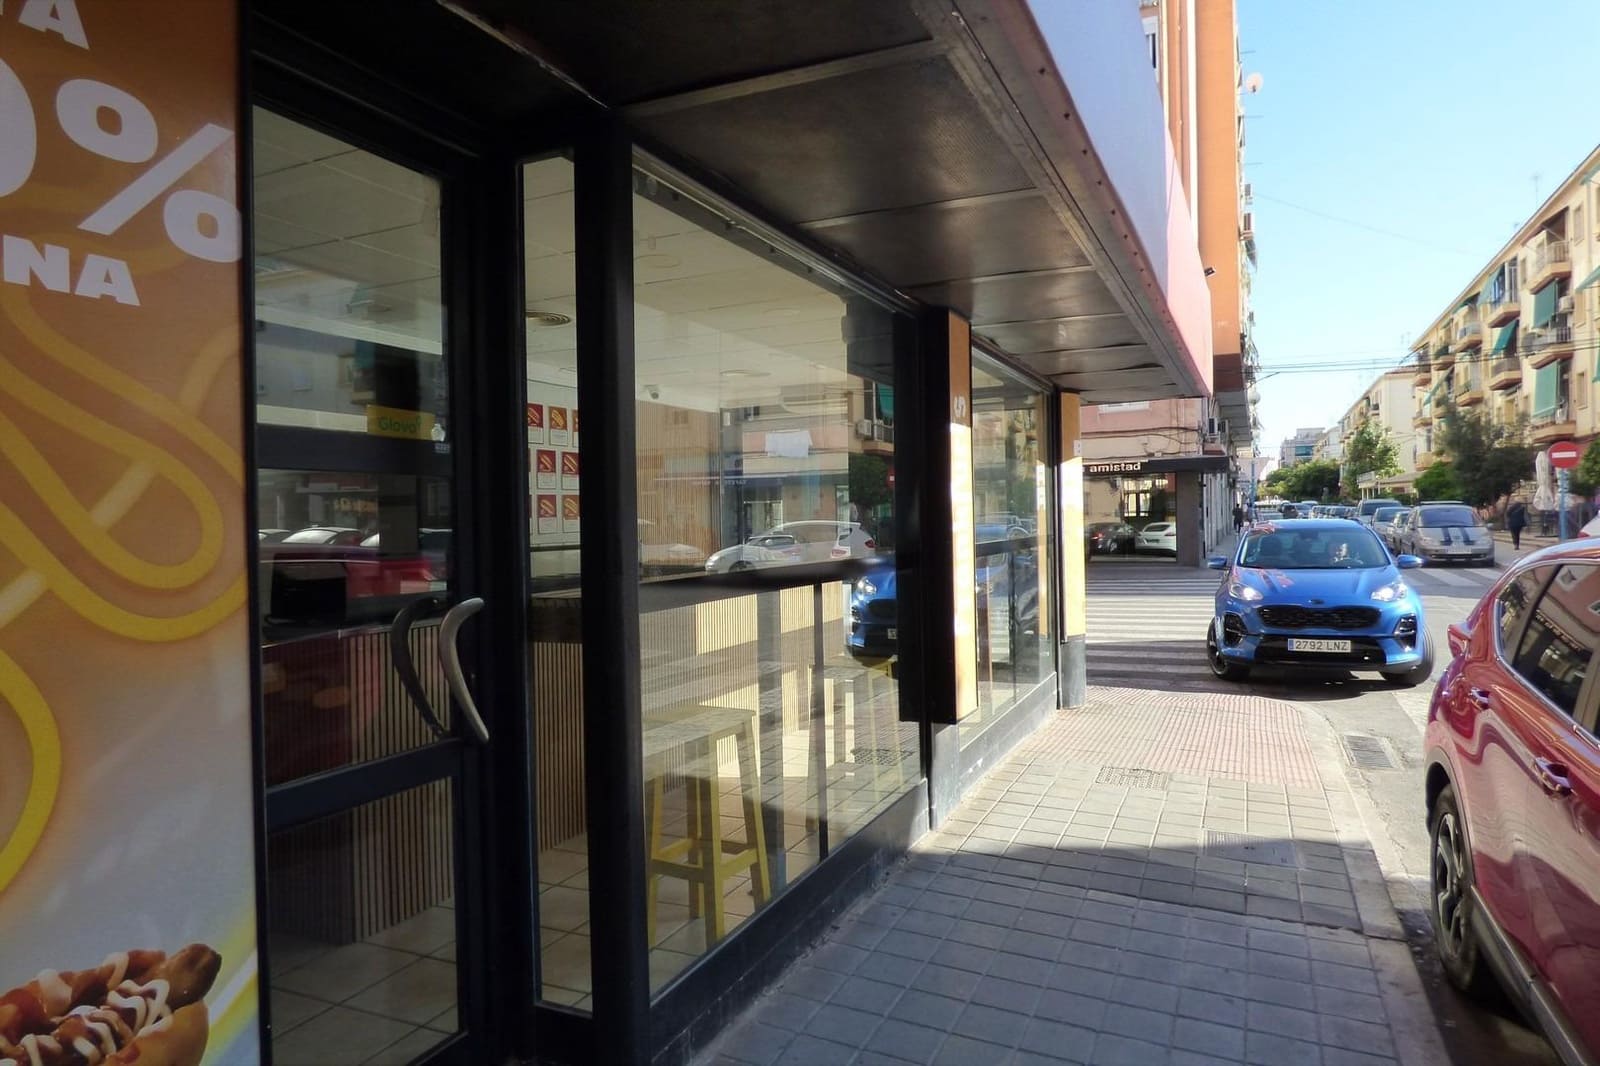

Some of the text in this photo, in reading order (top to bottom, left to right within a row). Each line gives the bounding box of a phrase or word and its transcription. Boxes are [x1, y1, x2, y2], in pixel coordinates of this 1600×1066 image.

[1089, 461, 1141, 473] amistad
[1295, 640, 1349, 651] 2792 LNZ
